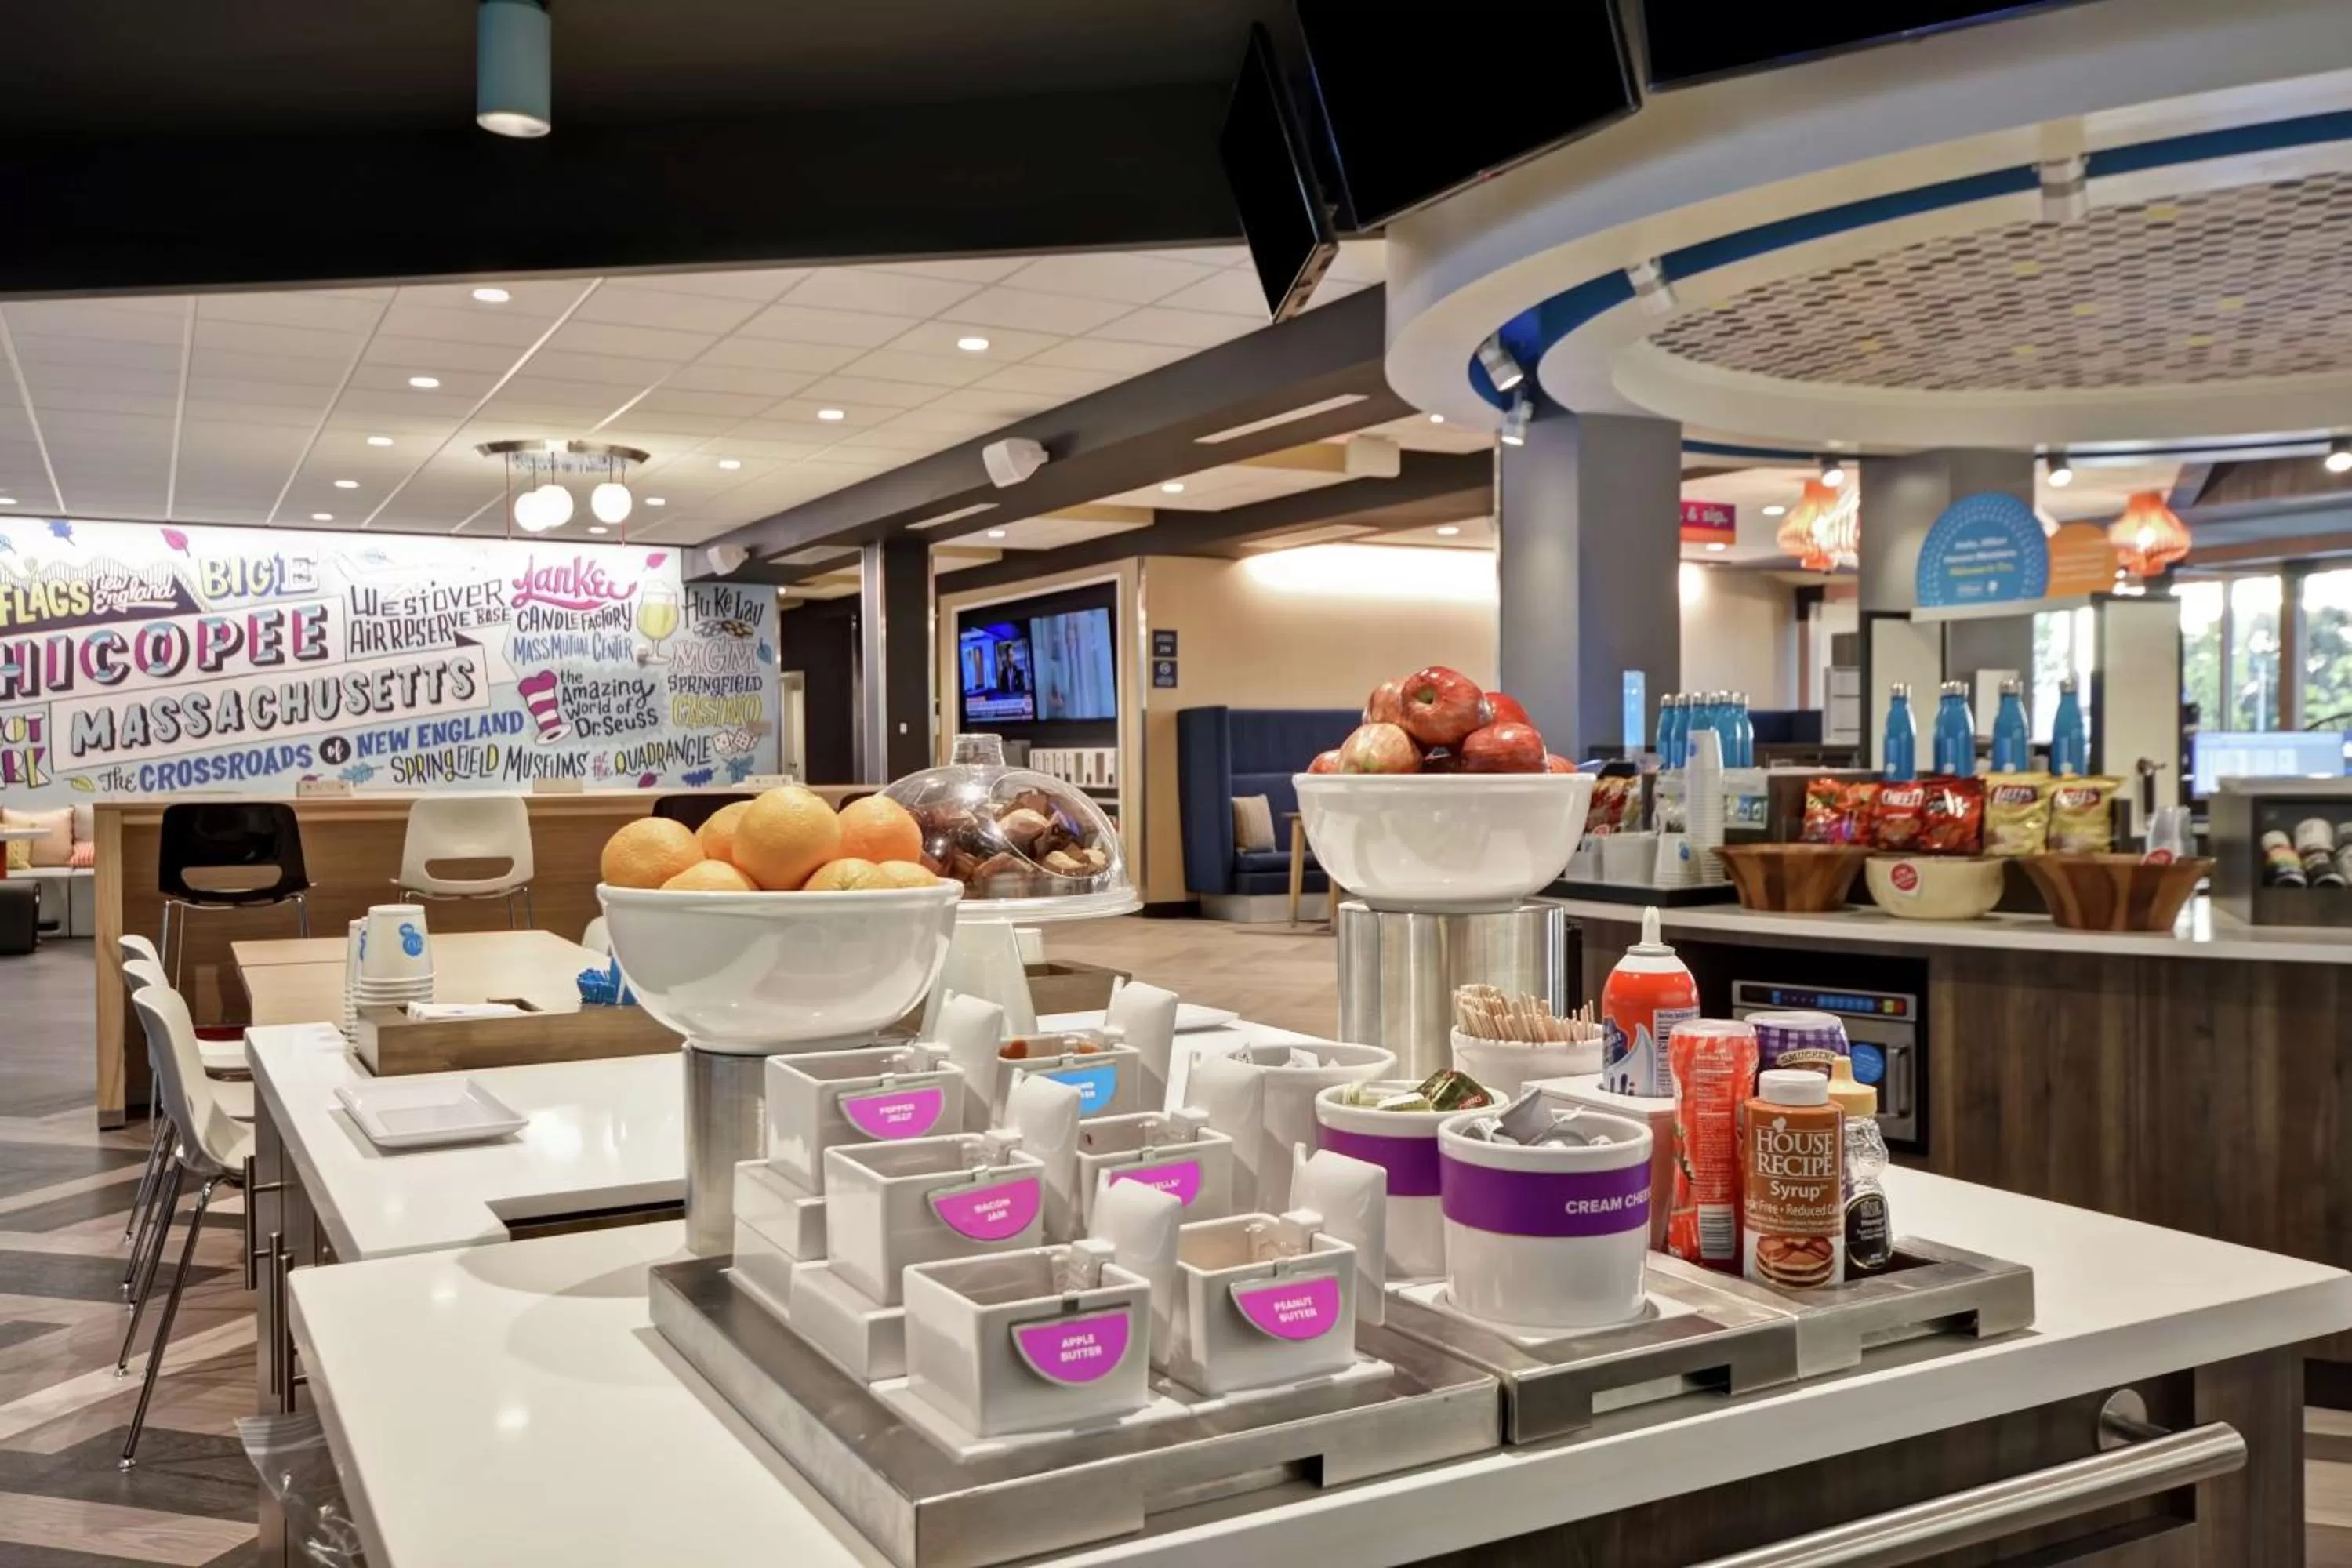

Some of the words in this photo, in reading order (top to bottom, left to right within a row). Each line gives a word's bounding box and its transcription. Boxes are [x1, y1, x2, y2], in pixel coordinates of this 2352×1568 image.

[92, 573, 131, 591] New
[199, 554, 275, 599] BIG
[0, 579, 91, 626] FLAGS
[92, 575, 178, 615] England
[474, 606, 514, 626] BASE
[517, 605, 579, 633] CANDLE
[581, 601, 632, 632] FACTORY
[592, 632, 634, 663] CENTER
[670, 637, 760, 675] MGM
[561, 670, 583, 684] the
[71, 657, 476, 757] MASSACHUSETTS
[562, 679, 655, 709] Amazing
[616, 697, 633, 714] of
[673, 693, 764, 729] CASINO
[139, 743, 313, 793] CROSSROADS
[325, 740, 346, 762] of
[356, 727, 412, 760] NEW
[417, 710, 524, 749] ENGLAND
[503, 744, 590, 782] MUSEUMS
[614, 734, 713, 777] QUADRANGLE
[1756, 1128, 1834, 1155] HOUSE
[1756, 1152, 1834, 1177] RECIPE
[1769, 1180, 1820, 1202] Syrup
[1565, 1196, 1623, 1214] CREAM
[1273, 1295, 1312, 1313] PEANUT
[1279, 1307, 1318, 1323] BUTTER
[1060, 1345, 1102, 1363] BUTTER
[1061, 1333, 1095, 1348] APPLE
